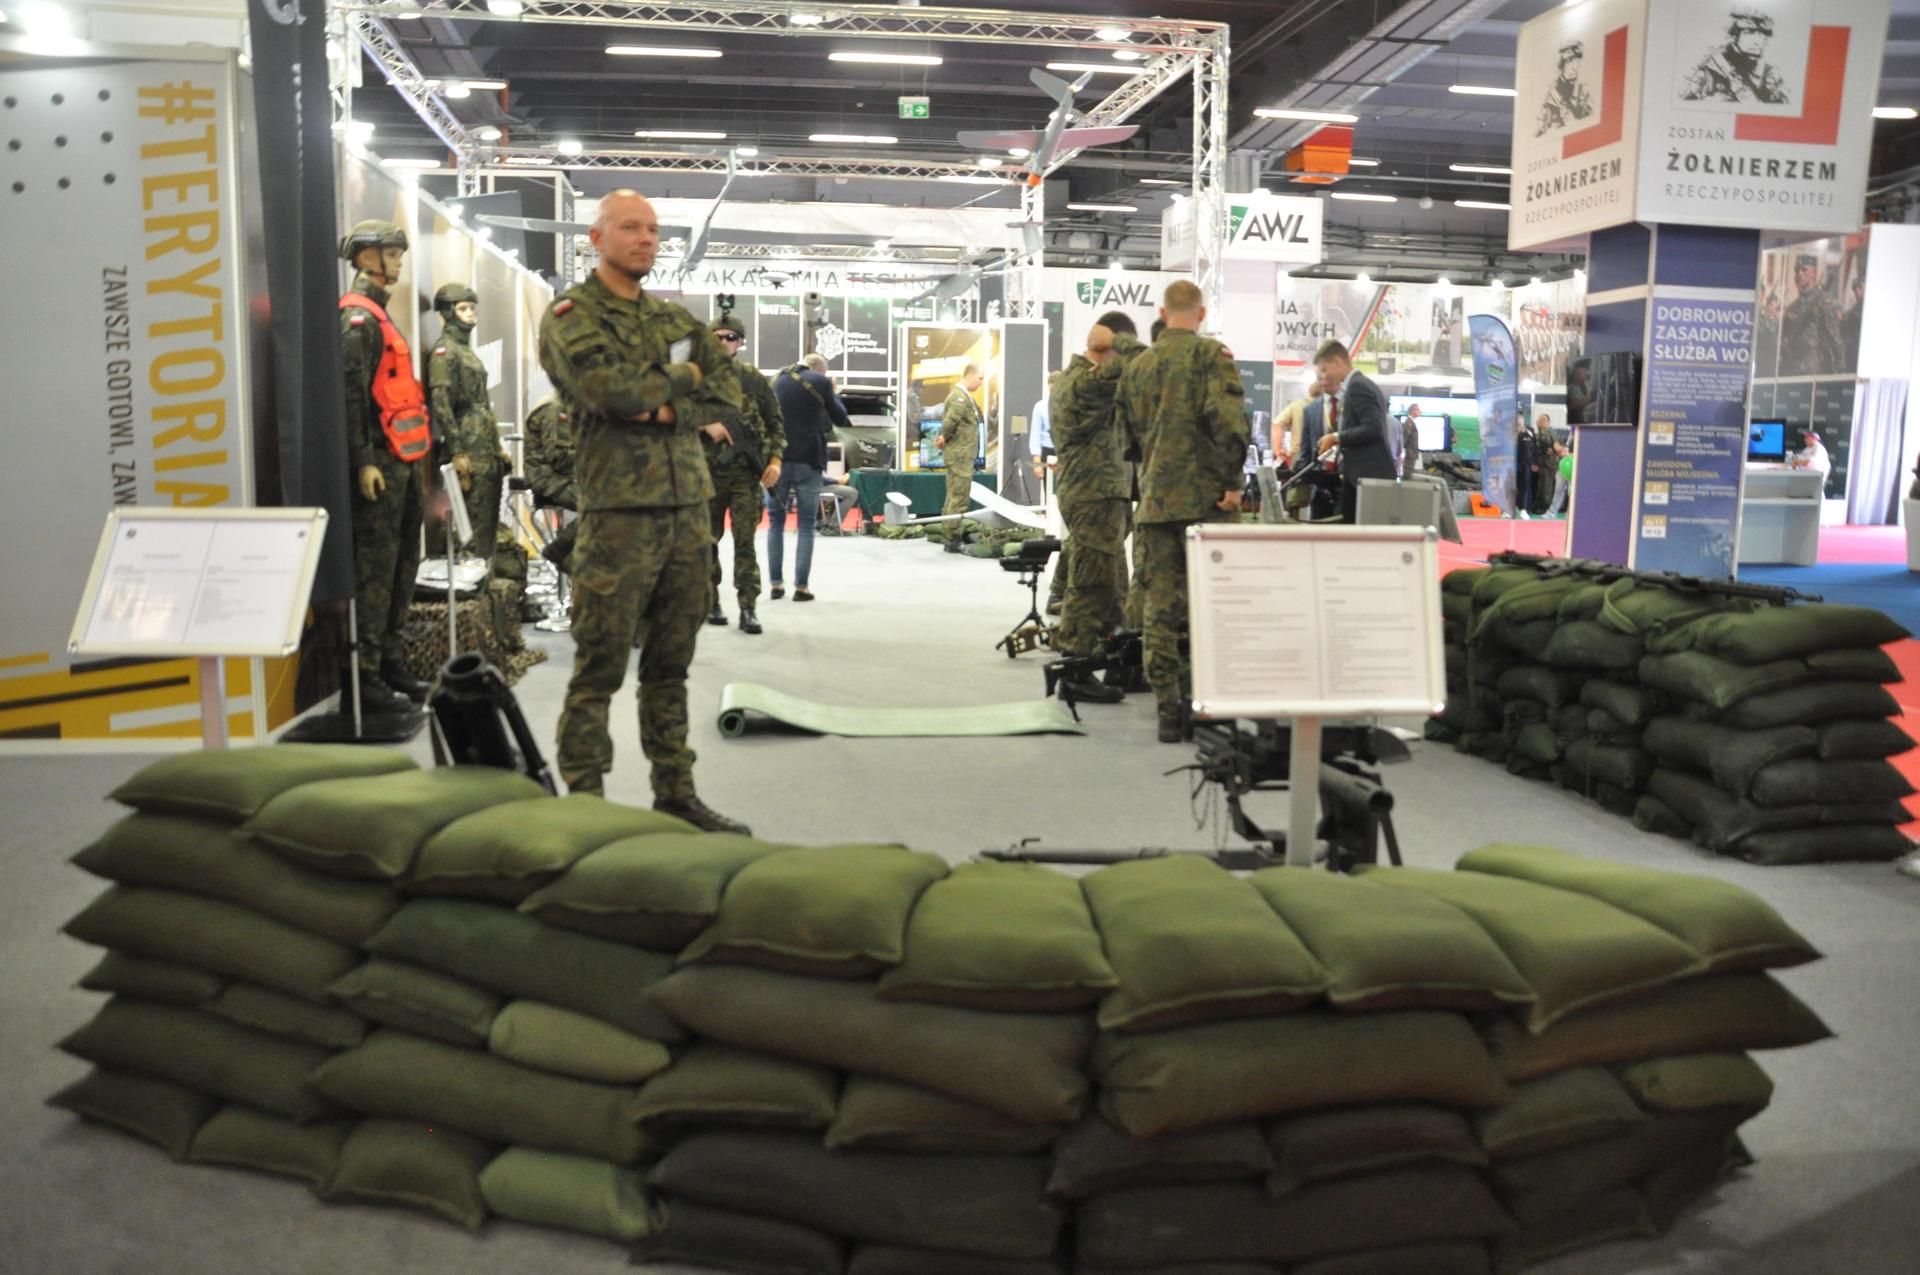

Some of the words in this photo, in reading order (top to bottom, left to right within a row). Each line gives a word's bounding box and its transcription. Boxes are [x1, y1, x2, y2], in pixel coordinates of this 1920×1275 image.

[1669, 126, 1725, 141] ZOSTAŃ
[1667, 147, 1837, 181] ŻOŁNIERZEM
[1526, 157, 1622, 202] ŻOŁNIERZEM
[1525, 187, 1620, 224] RZECZYPOSPOLITEJ
[1665, 183, 1834, 207] RZECZYPOSPOLITEJ
[1242, 210, 1309, 243] AWL
[103, 264, 130, 353] ZAWSZE
[1102, 281, 1155, 307] AWL
[1657, 305, 1754, 326] DOBROWOL
[1655, 325, 1751, 344] ZASADNICZ
[1654, 341, 1718, 361] SŁUŻBA
[1721, 346, 1750, 363] WO
[106, 359, 134, 455] GOTOWI,
